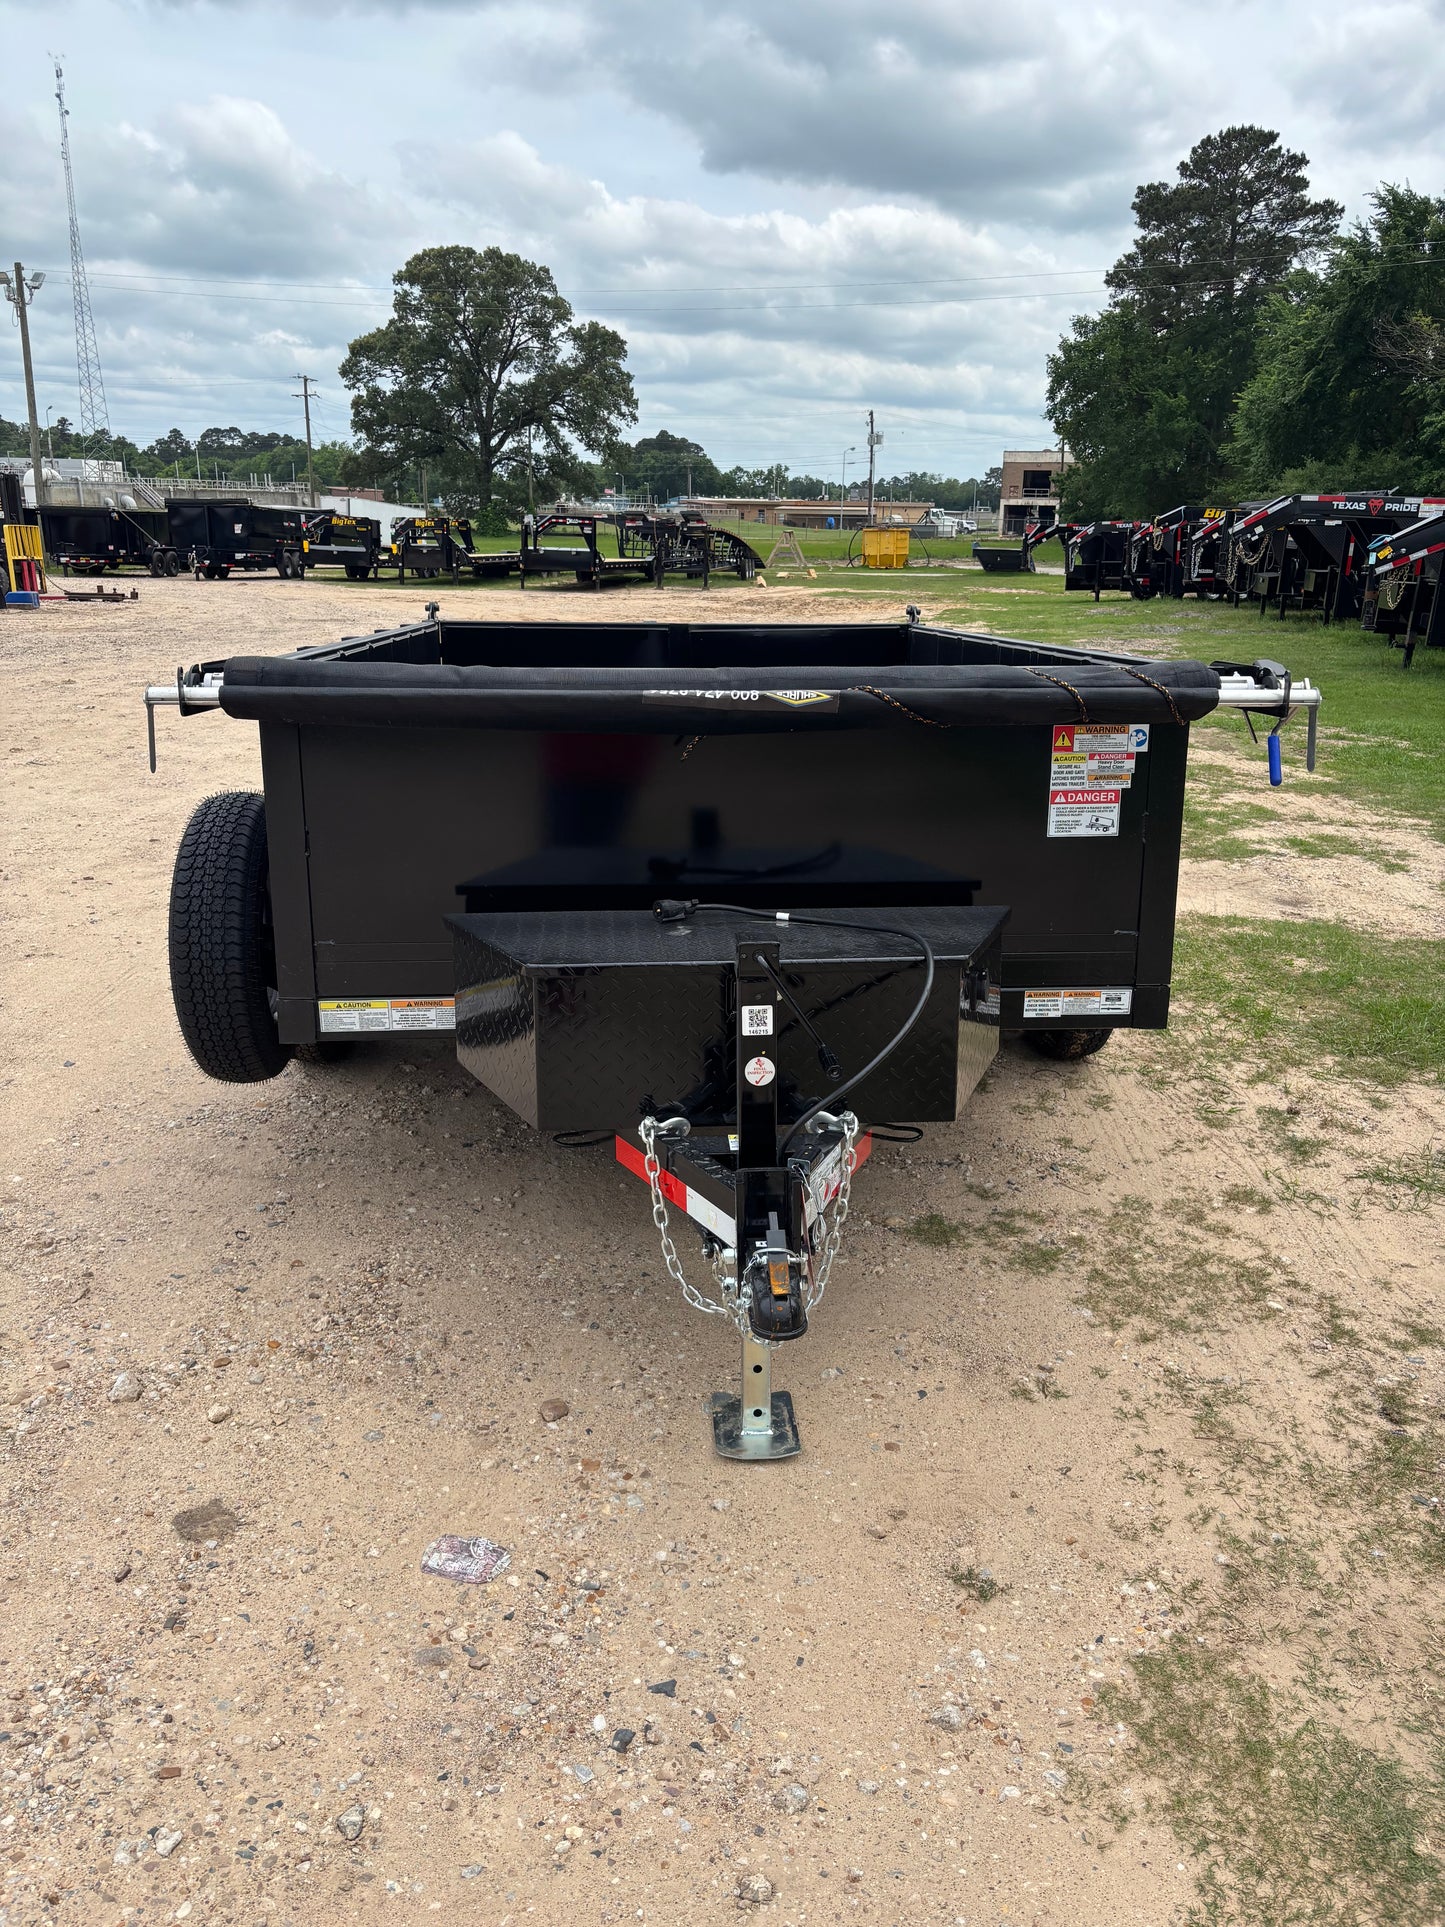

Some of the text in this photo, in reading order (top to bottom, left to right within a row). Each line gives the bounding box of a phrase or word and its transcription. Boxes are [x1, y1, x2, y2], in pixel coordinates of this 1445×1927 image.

[1332, 501, 1367, 511] TEXAS
[1384, 503, 1418, 512] PRIDE
[1086, 726, 1126, 734] WARNING
[1067, 792, 1116, 802] DANGER
